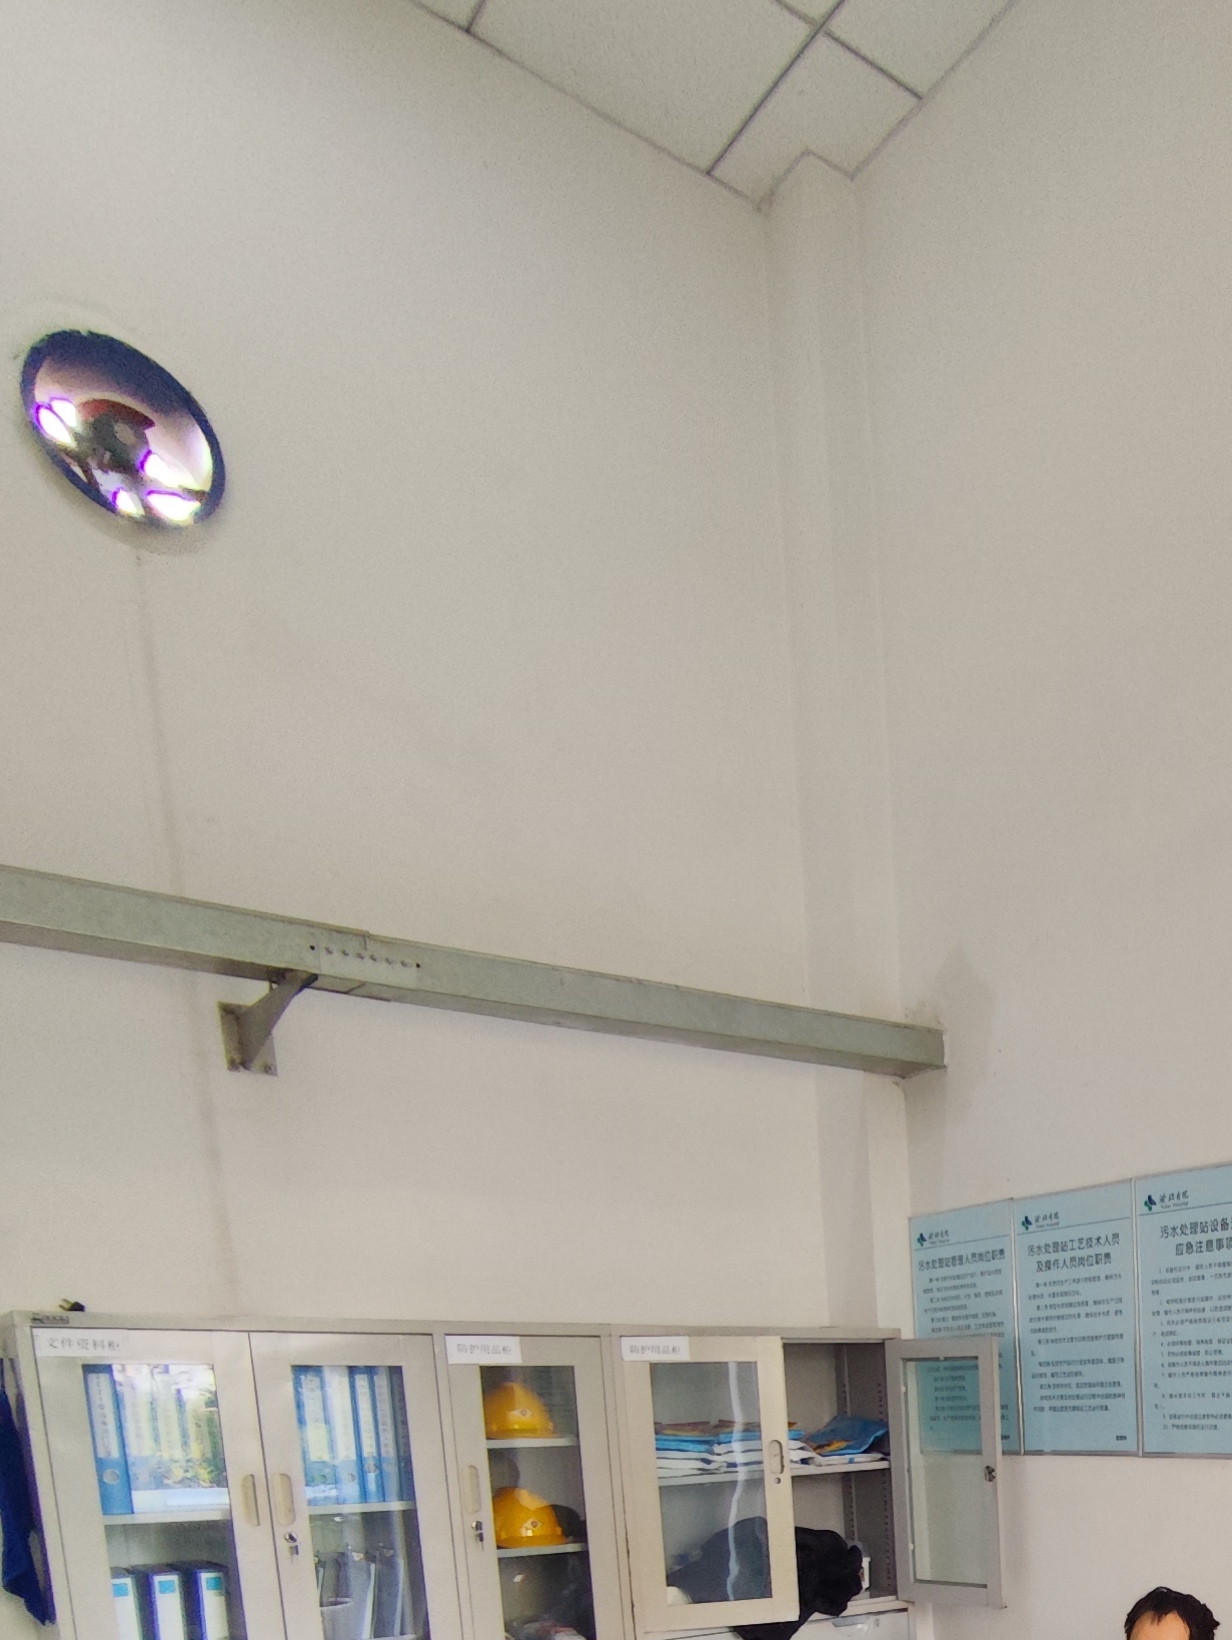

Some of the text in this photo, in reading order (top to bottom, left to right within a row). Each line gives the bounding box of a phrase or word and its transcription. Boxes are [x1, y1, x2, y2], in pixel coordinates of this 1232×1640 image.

[1027, 1232, 1120, 1257] 污水处理站工艺技术人员
[1036, 1252, 1112, 1273] 及操作人员岗位职责
[46, 1337, 120, 1351] 文件资料柜
[456, 1343, 512, 1356] 防护用品柜
[629, 1344, 681, 1355] 防护用品柜
